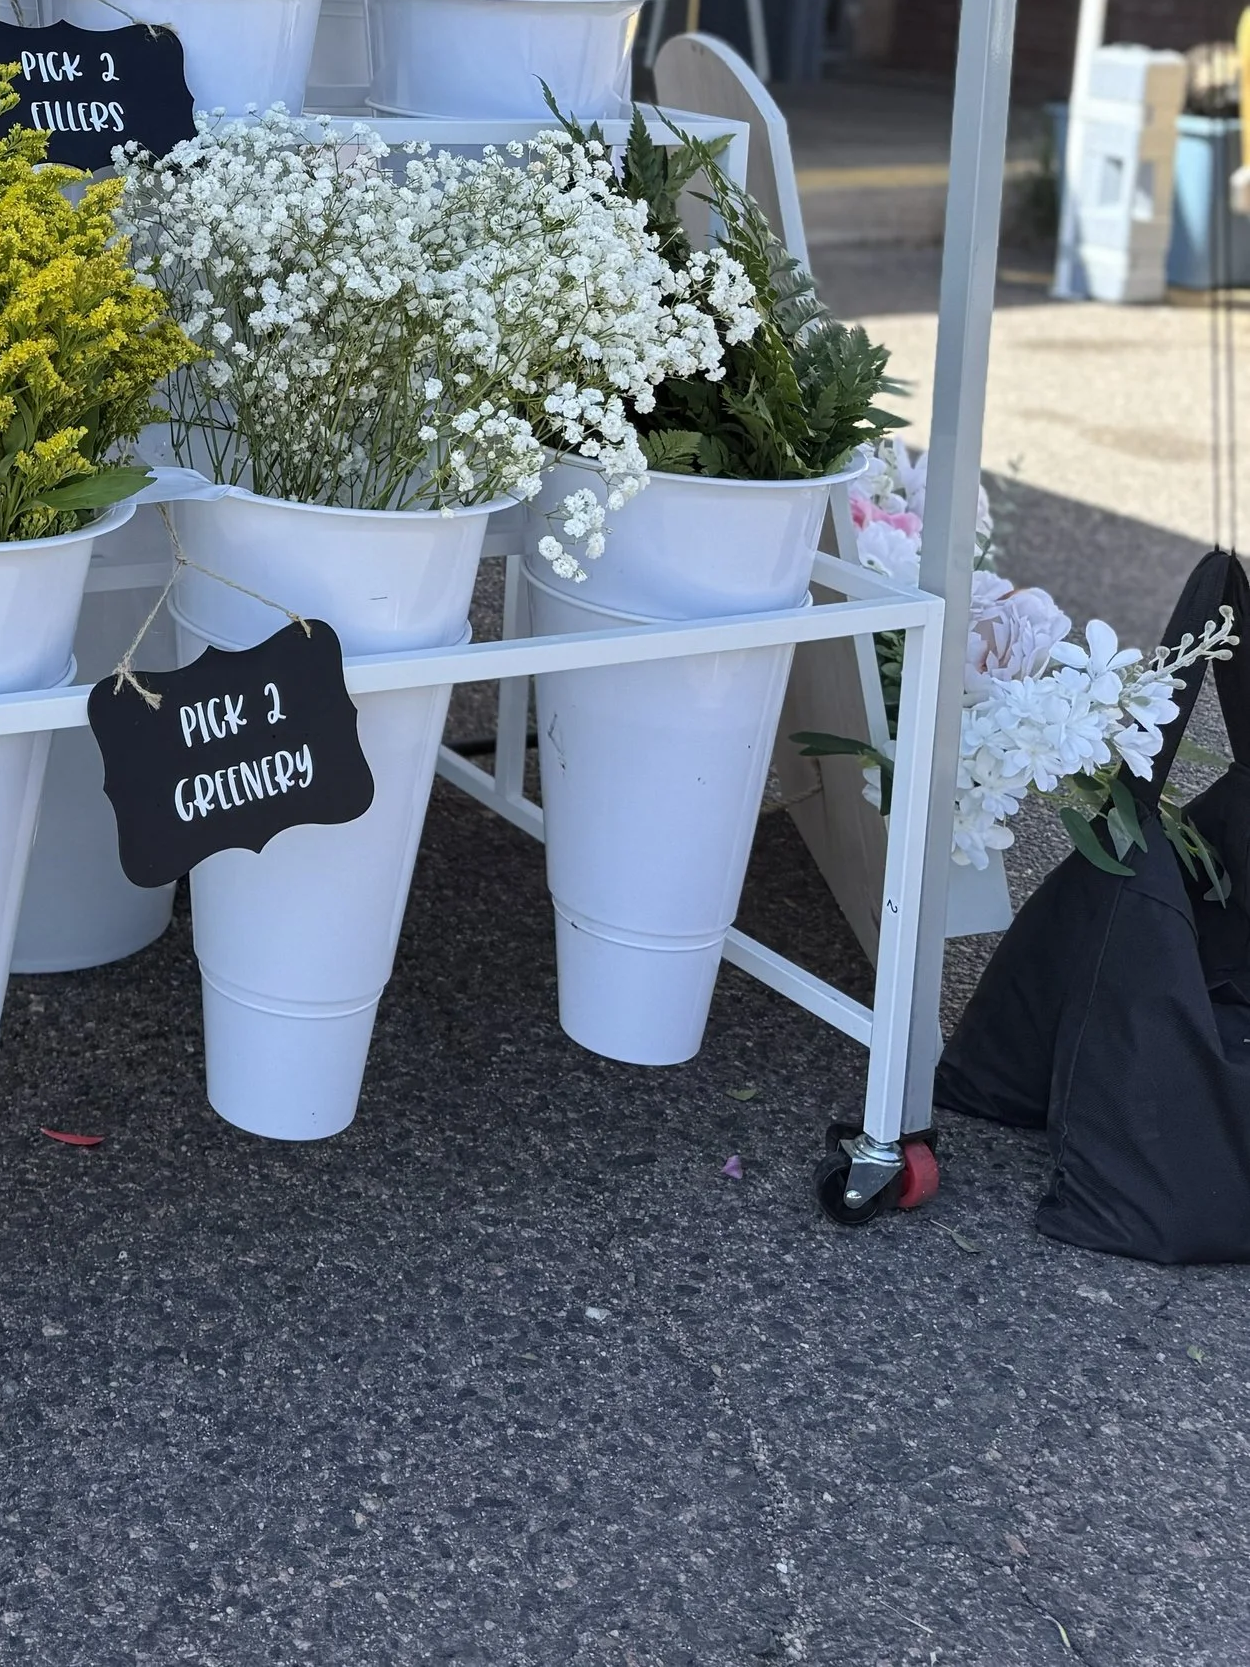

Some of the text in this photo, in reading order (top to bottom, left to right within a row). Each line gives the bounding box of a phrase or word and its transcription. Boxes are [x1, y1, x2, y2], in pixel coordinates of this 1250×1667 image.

[20, 50, 120, 83] PICK 2
[30, 100, 125, 133] FILLERS
[179, 682, 287, 748] PICK 2
[173, 743, 313, 823] GREENERY
